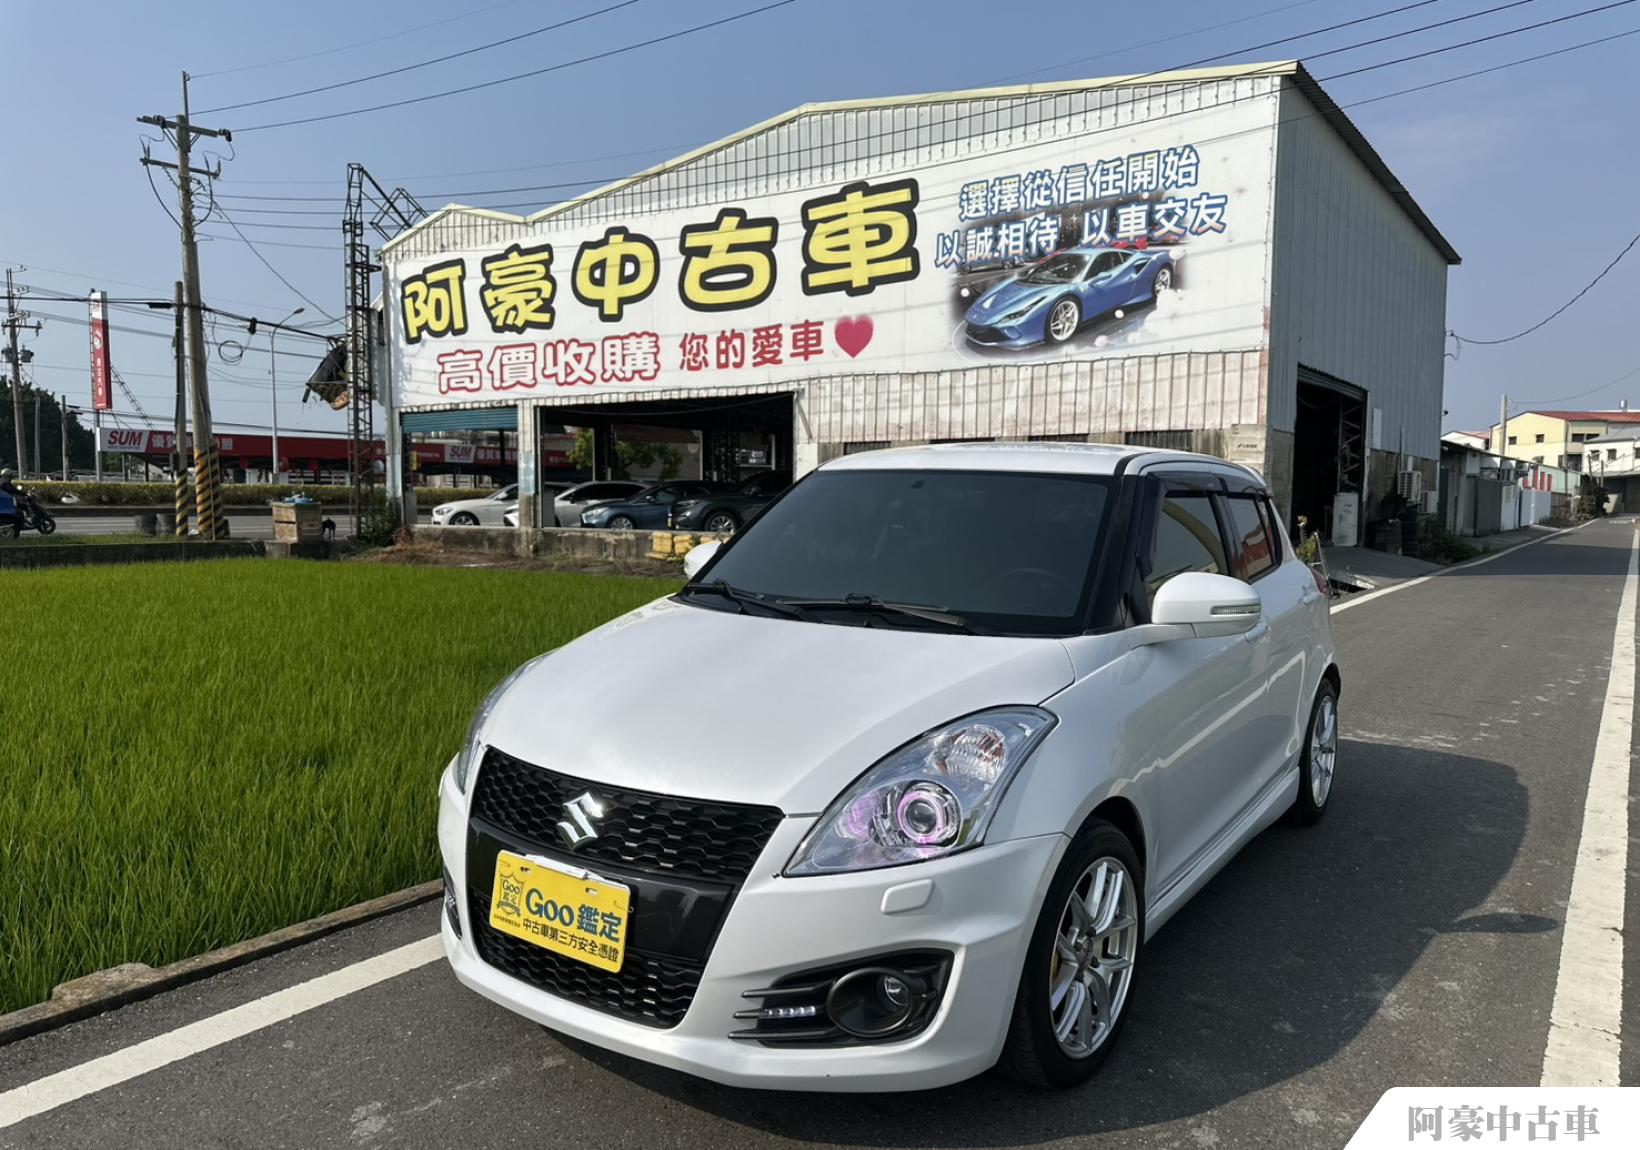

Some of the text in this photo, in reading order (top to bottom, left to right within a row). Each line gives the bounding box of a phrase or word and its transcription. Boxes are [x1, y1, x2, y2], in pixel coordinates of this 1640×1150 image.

[959, 145, 1200, 221] 選擇從信任開始
[402, 178, 919, 343] 阿豪中古車
[935, 193, 1228, 268] 以誠相待 以車交友
[437, 320, 825, 394] 高價收購 您的愛車
[108, 430, 143, 446] SUM
[450, 445, 472, 458] SUM
[502, 880, 521, 895] Goo
[525, 887, 622, 943] Goo 鑑定
